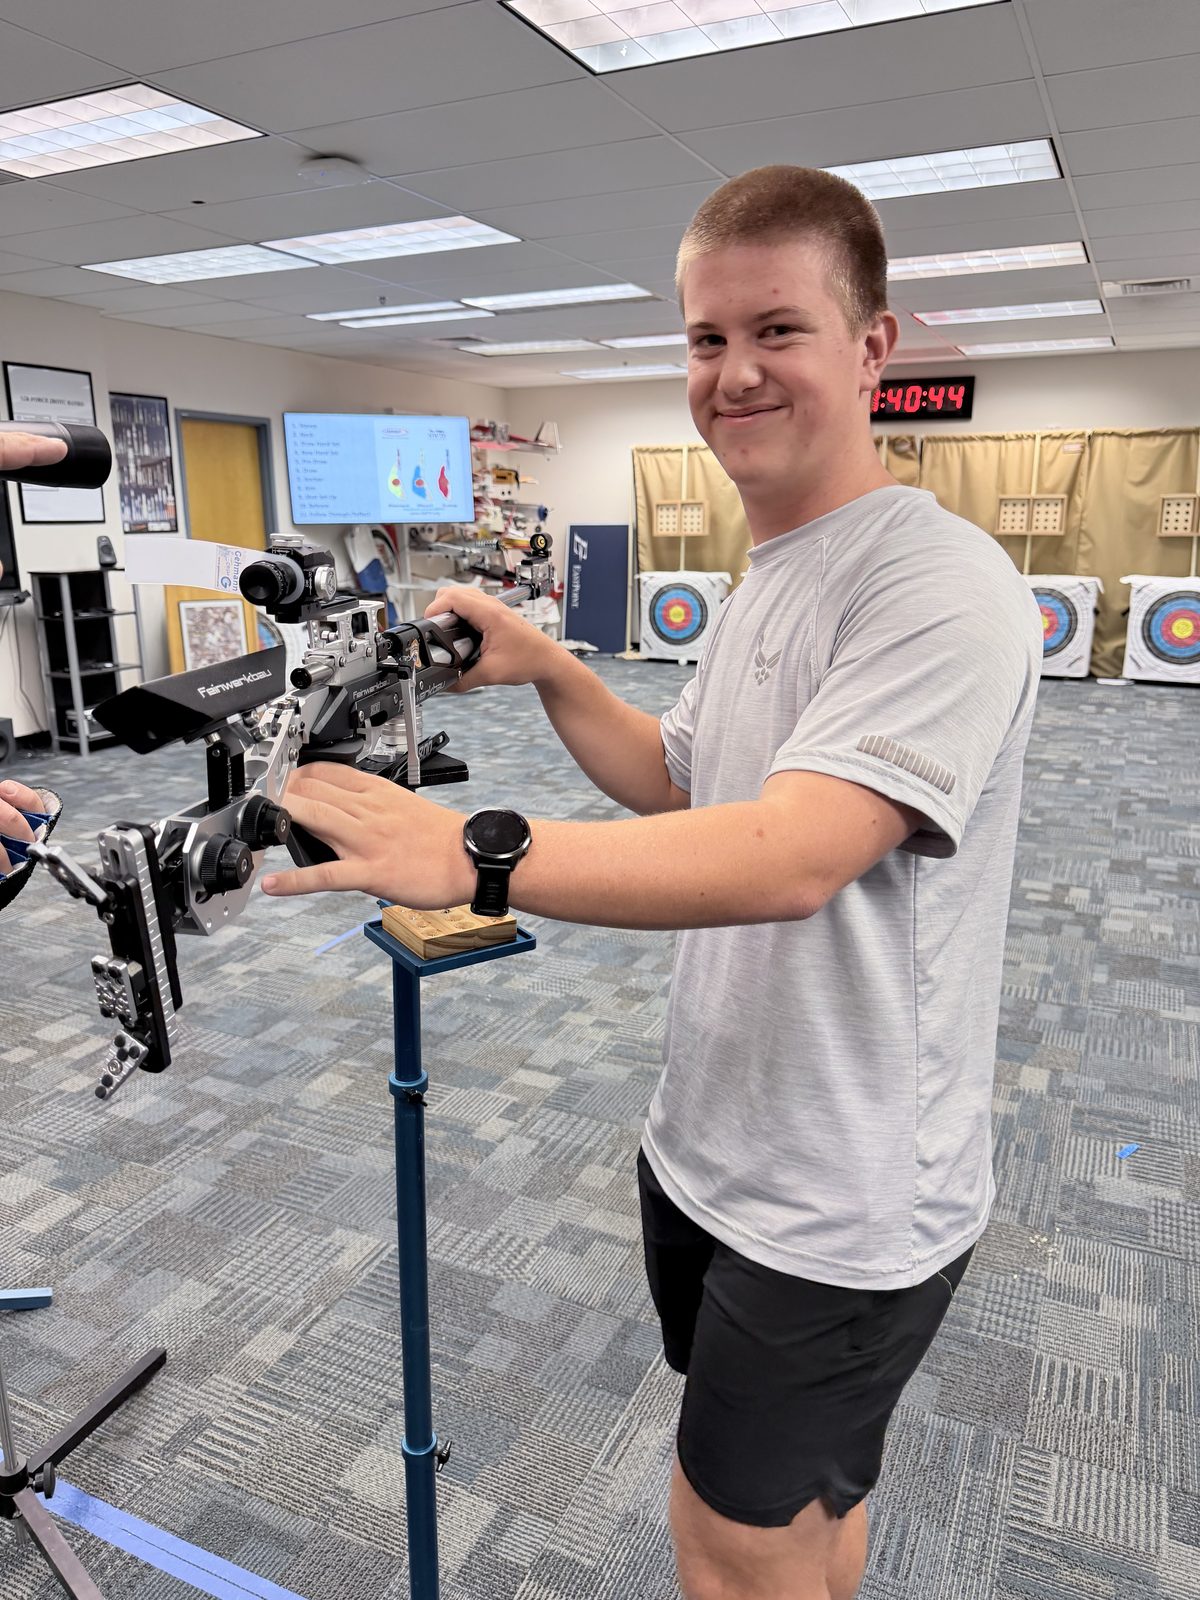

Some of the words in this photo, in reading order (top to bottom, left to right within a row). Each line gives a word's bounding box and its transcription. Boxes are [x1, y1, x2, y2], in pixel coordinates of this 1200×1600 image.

[232, 550, 242, 592] Gehmann
[197, 669, 272, 699] Feinwerkbau
[353, 680, 391, 699] Feinwerkbau
